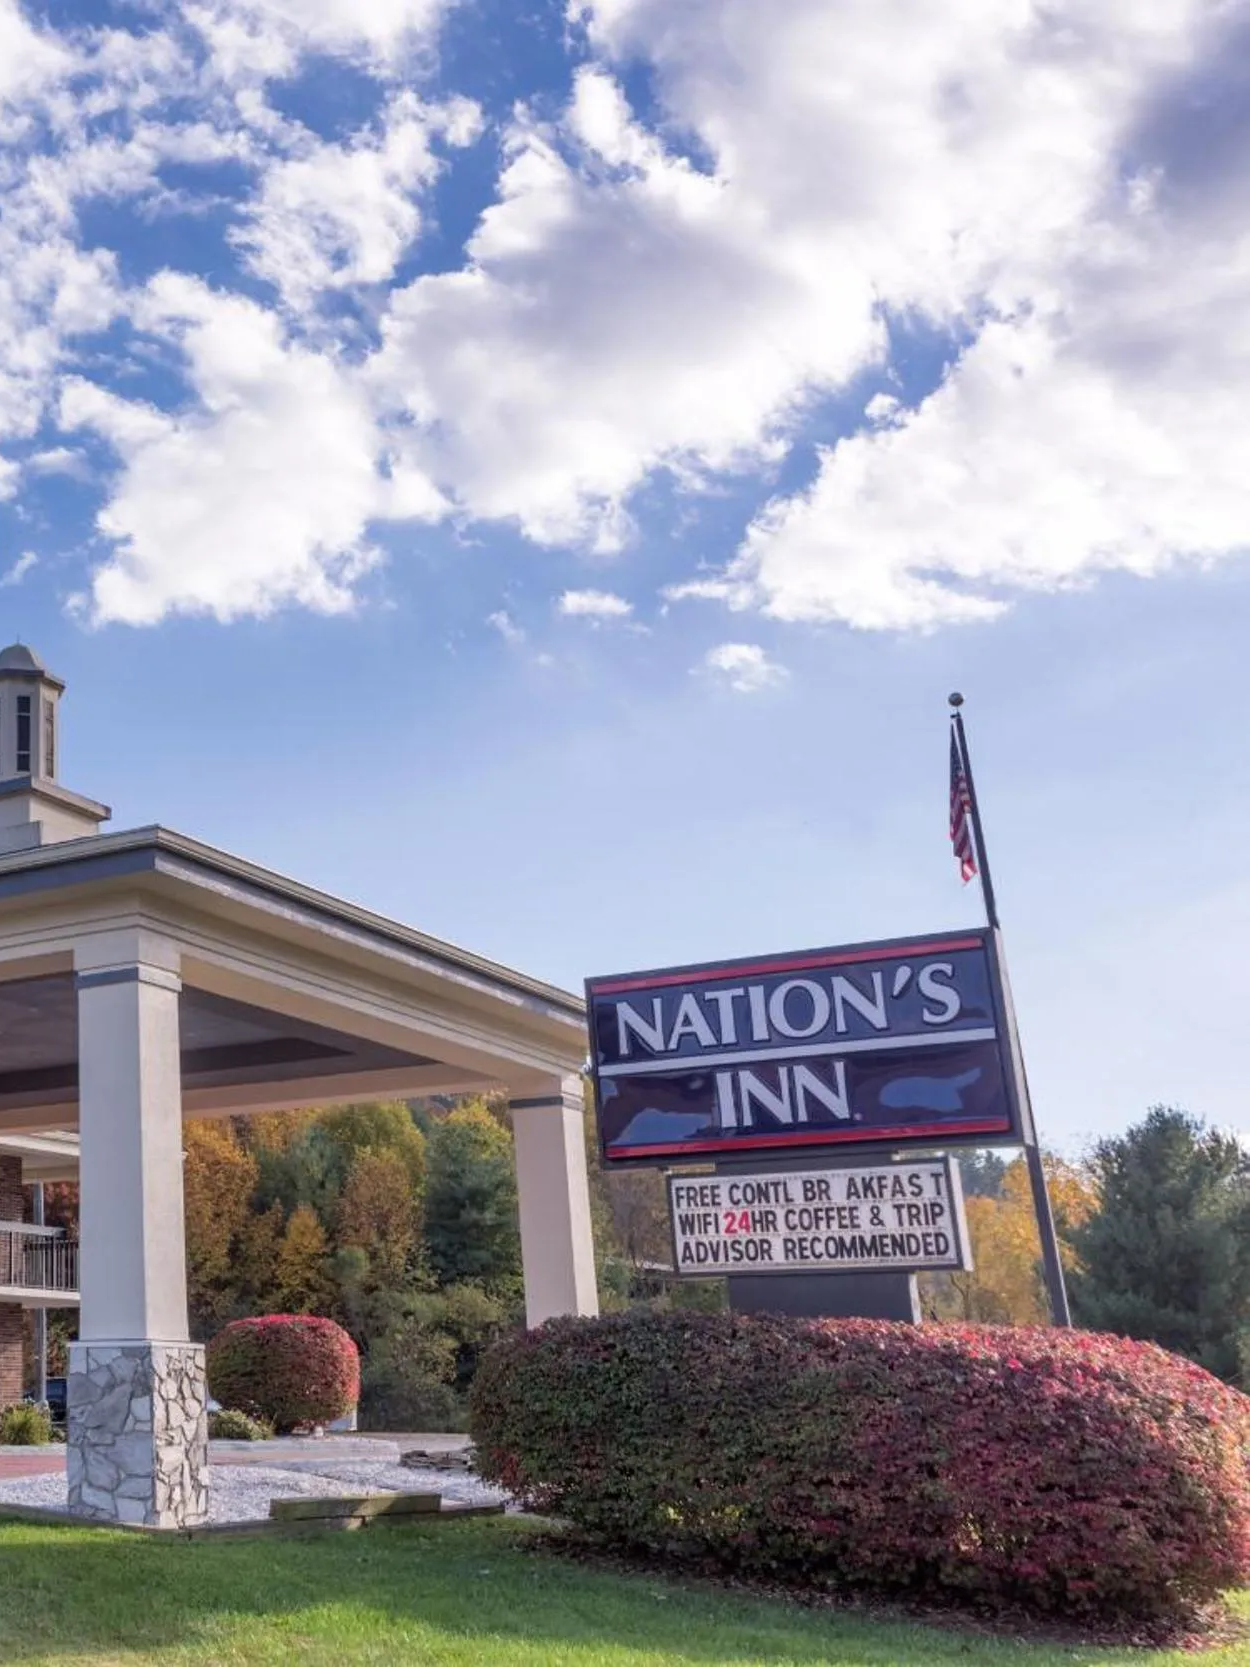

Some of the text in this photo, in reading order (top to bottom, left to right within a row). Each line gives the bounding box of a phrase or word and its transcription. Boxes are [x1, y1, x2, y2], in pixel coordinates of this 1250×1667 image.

[615, 962, 961, 1056] NATION'S
[715, 1061, 850, 1128] INN
[675, 1184, 721, 1208] FREE
[728, 1180, 791, 1206] CONTL
[678, 1211, 719, 1235] WIFI
[785, 1207, 860, 1231] COFFEE
[869, 1205, 885, 1226] &
[893, 1202, 944, 1228] TRIP
[681, 1232, 949, 1264] ADVISOR RECOMMENDED
